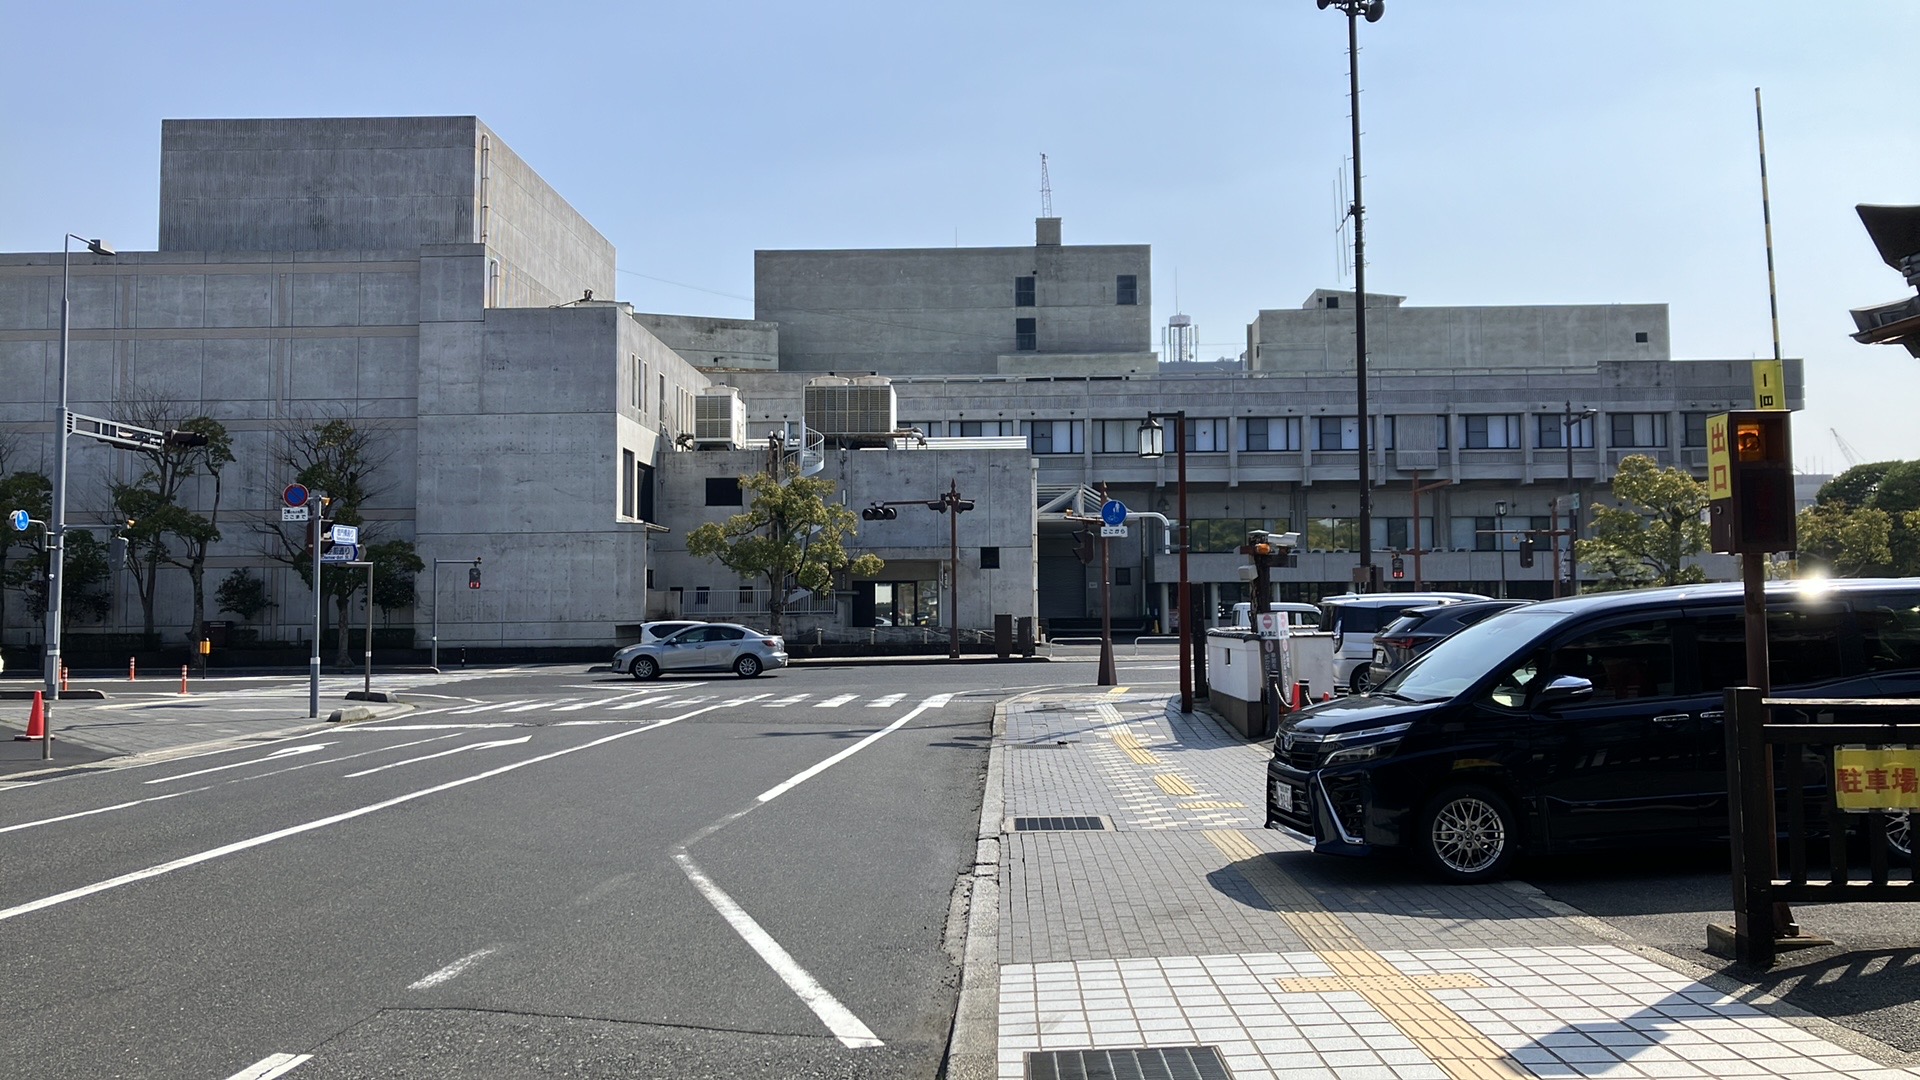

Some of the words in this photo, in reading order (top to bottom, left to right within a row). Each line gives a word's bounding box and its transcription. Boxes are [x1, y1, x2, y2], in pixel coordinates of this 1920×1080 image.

[1711, 422, 1727, 492] 出口
[1837, 767, 1919, 794] 駐車場
